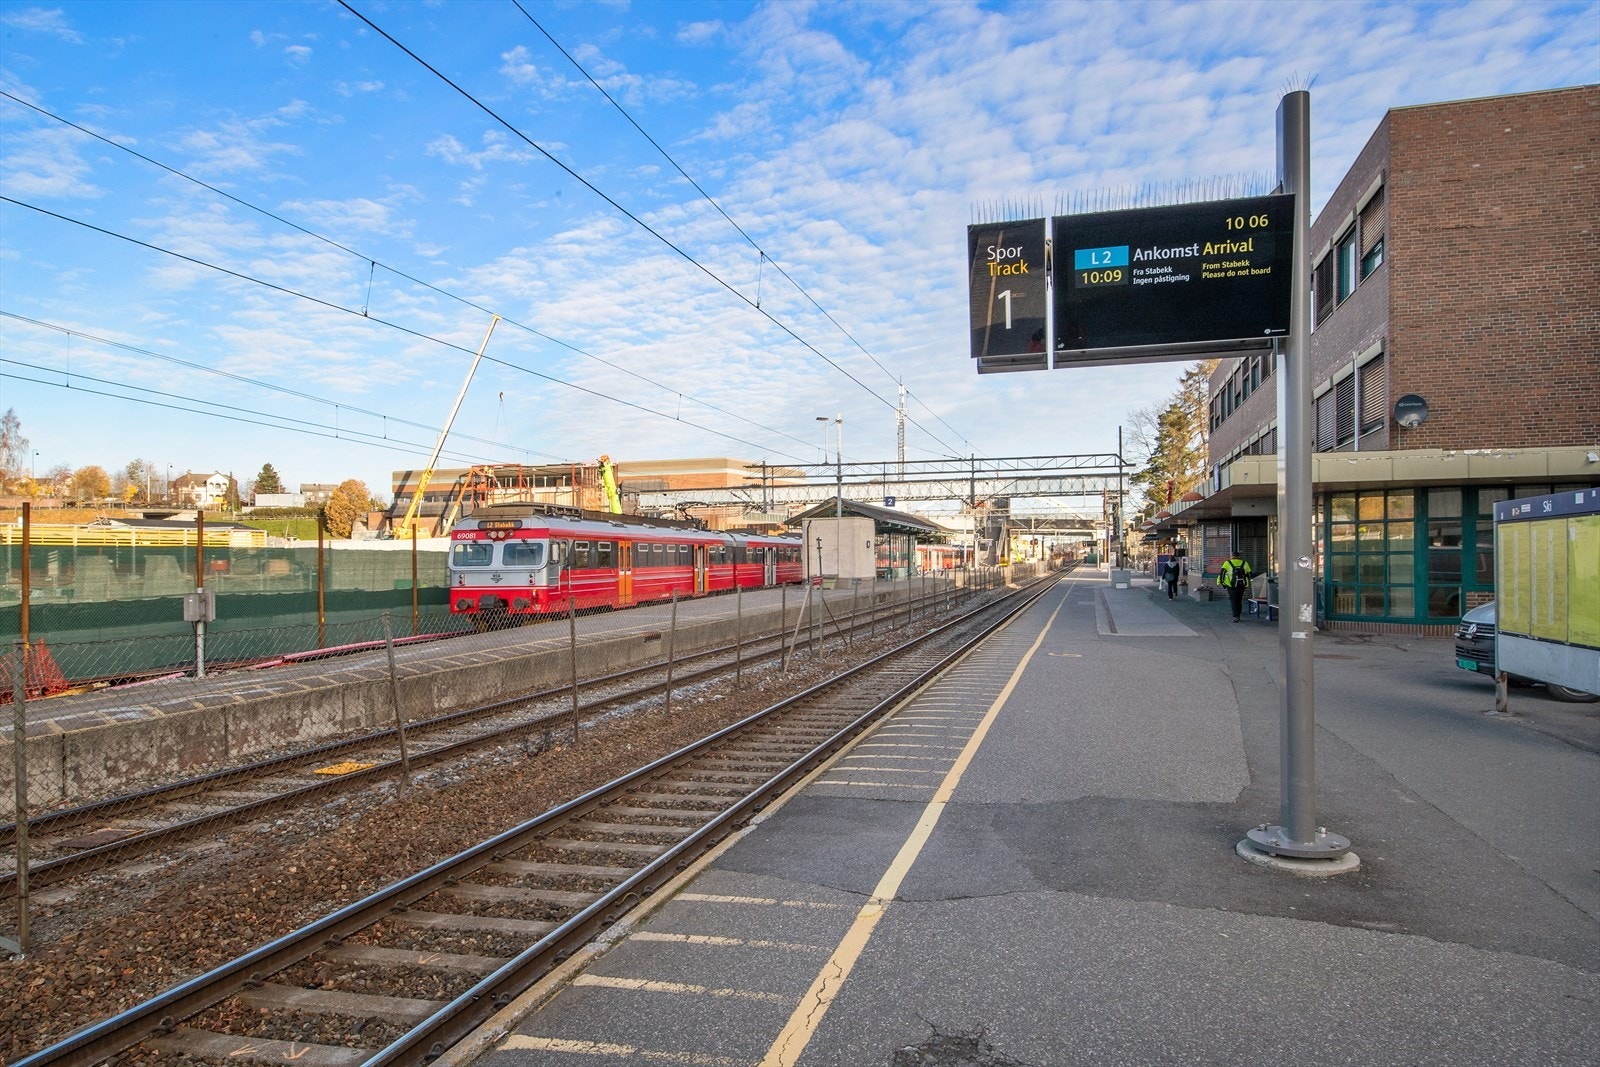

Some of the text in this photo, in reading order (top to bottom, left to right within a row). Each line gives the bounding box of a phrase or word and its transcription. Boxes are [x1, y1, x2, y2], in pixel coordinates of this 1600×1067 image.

[1226, 214, 1269, 230] 10 06
[987, 245, 1023, 261] Spor
[1133, 238, 1254, 262] Ankomst Arrival
[1092, 251, 1111, 265] L 2
[1222, 260, 1250, 268] Stabekk
[987, 259, 1029, 276] Track
[1146, 266, 1173, 274] Stabekk
[1202, 270, 1225, 278] Please
[1227, 269, 1236, 277] do
[1238, 268, 1249, 276] not
[1082, 269, 1122, 284] 10:09
[1133, 274, 1190, 285] Ingen påstigning
[997, 290, 1012, 330] 1
[1543, 500, 1552, 512] Ski
